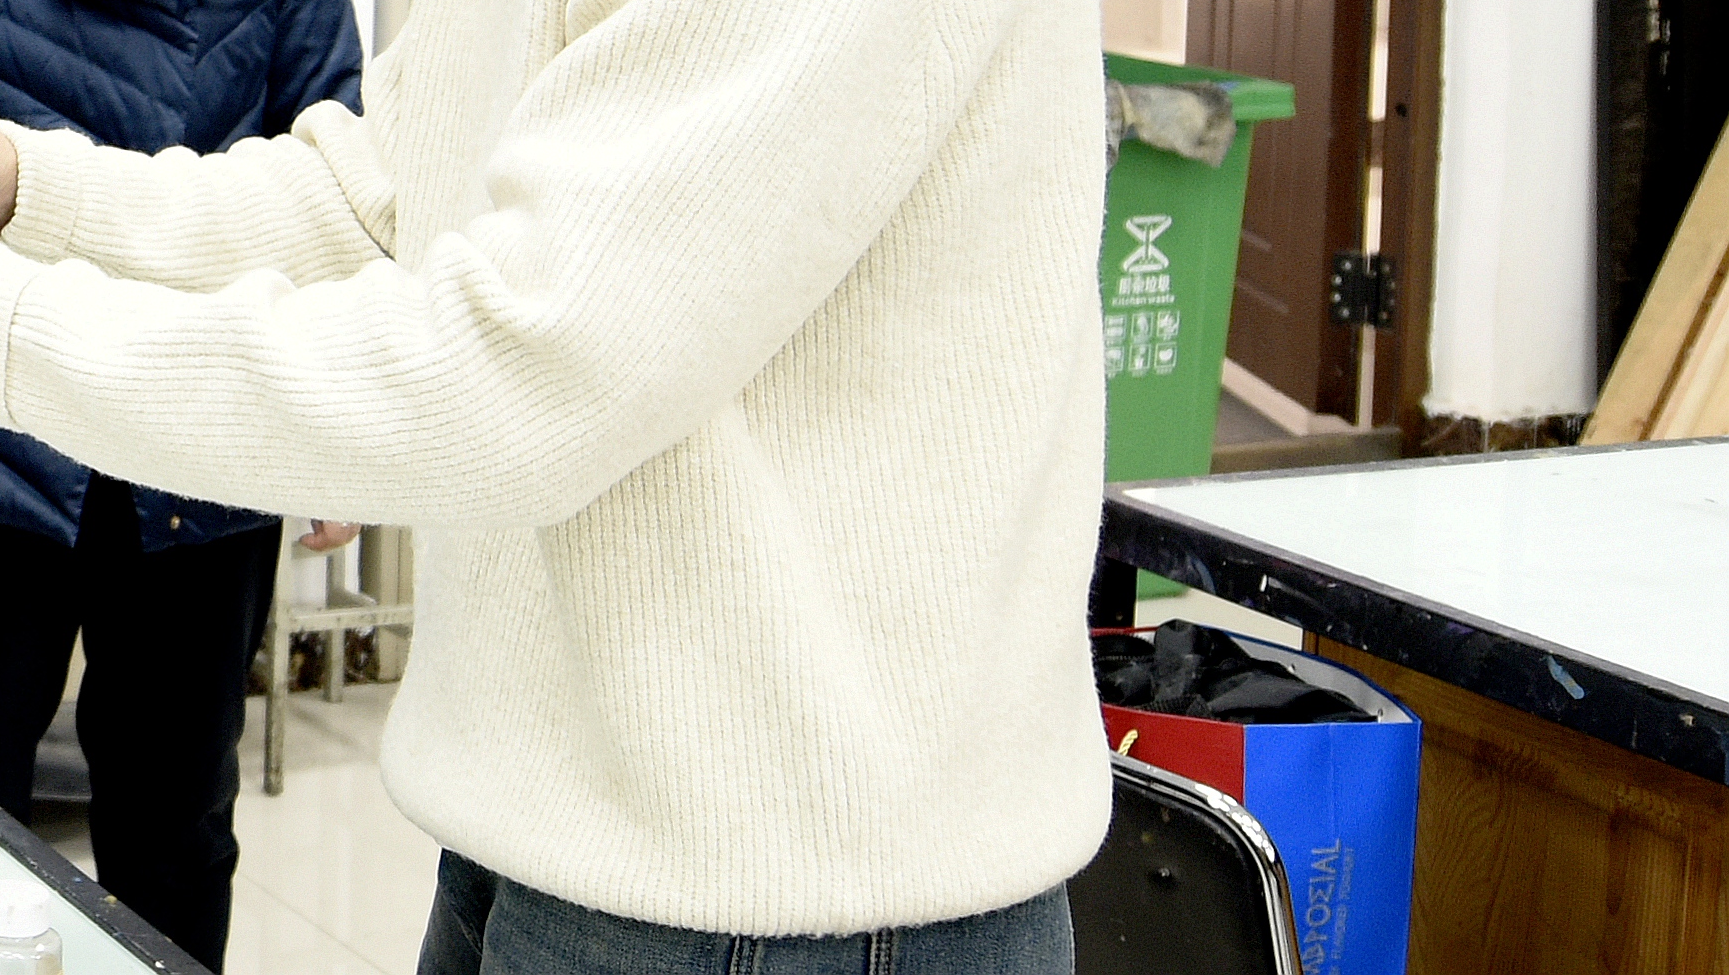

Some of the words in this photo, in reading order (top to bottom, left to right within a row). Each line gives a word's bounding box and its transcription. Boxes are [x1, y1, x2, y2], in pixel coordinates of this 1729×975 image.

[1118, 274, 1170, 294] 厨余垃圾
[1112, 296, 1147, 306] Kitchen
[1148, 295, 1175, 305] waste
